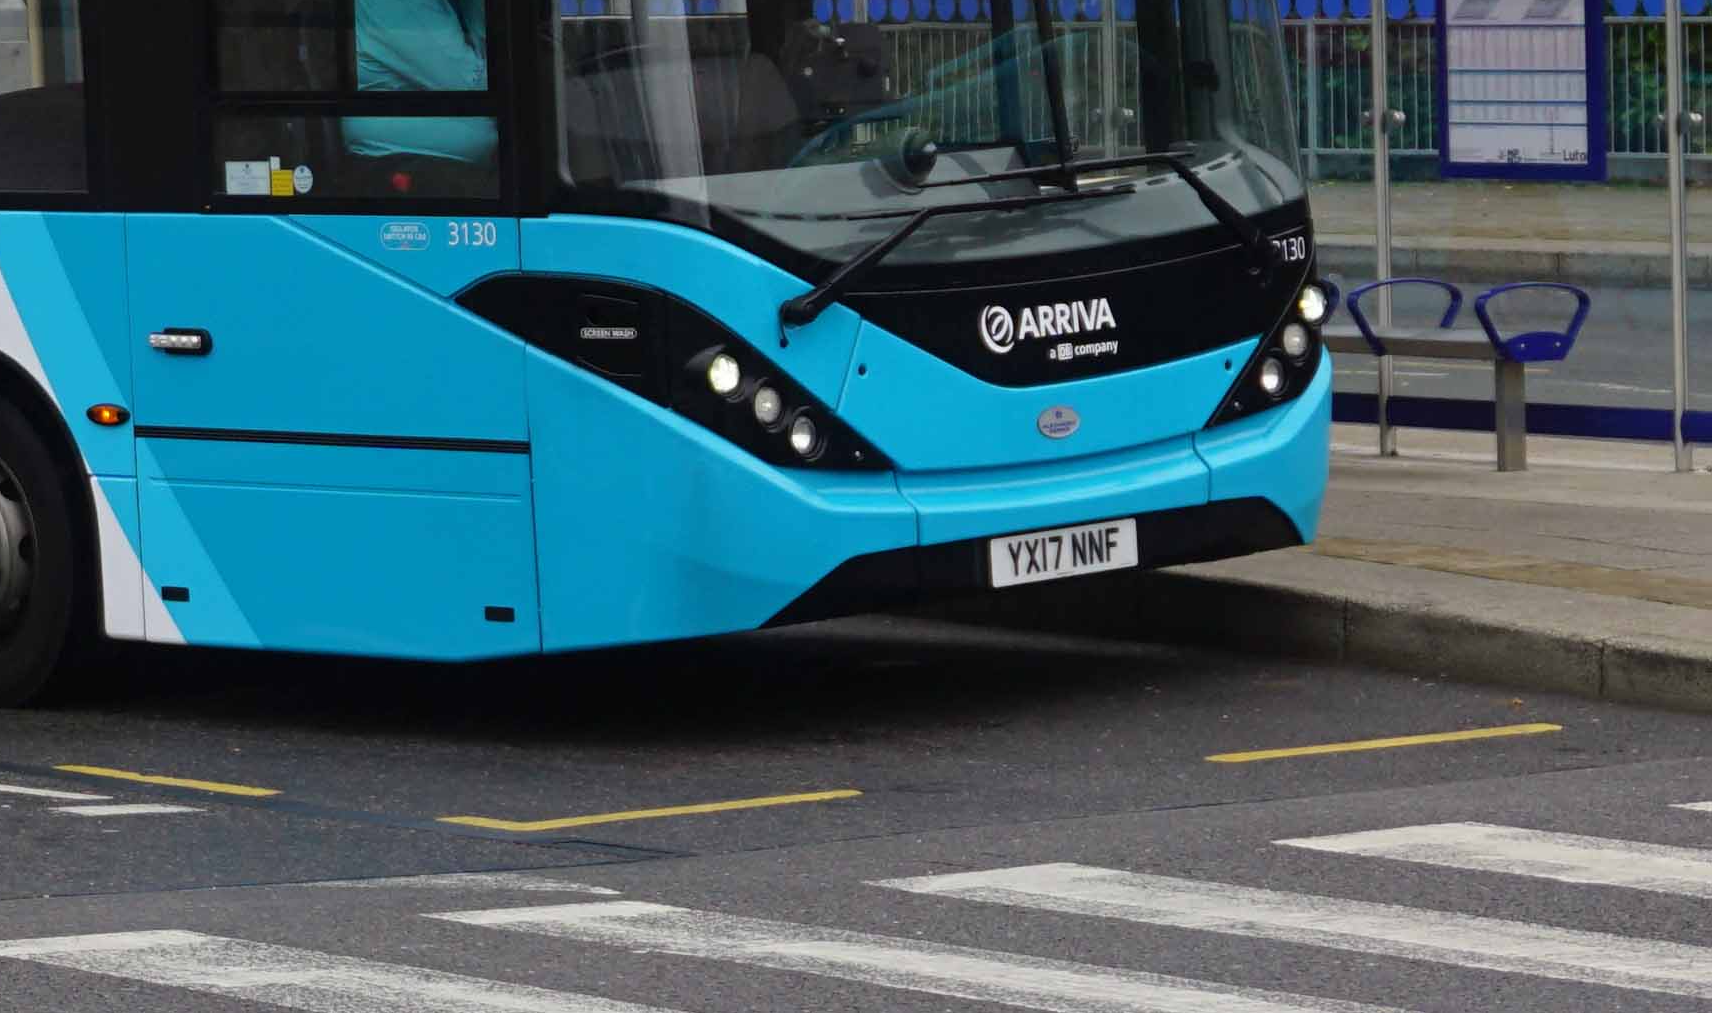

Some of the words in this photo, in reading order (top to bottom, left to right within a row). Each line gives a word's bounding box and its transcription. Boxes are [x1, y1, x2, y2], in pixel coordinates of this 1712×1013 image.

[448, 221, 497, 246] 3130
[1272, 236, 1306, 261] 130
[1018, 298, 1117, 340] ARRIVA
[1049, 348, 1056, 359] a
[1074, 339, 1119, 358] company
[1008, 536, 1064, 577] YX17
[1071, 527, 1120, 568] NNF
